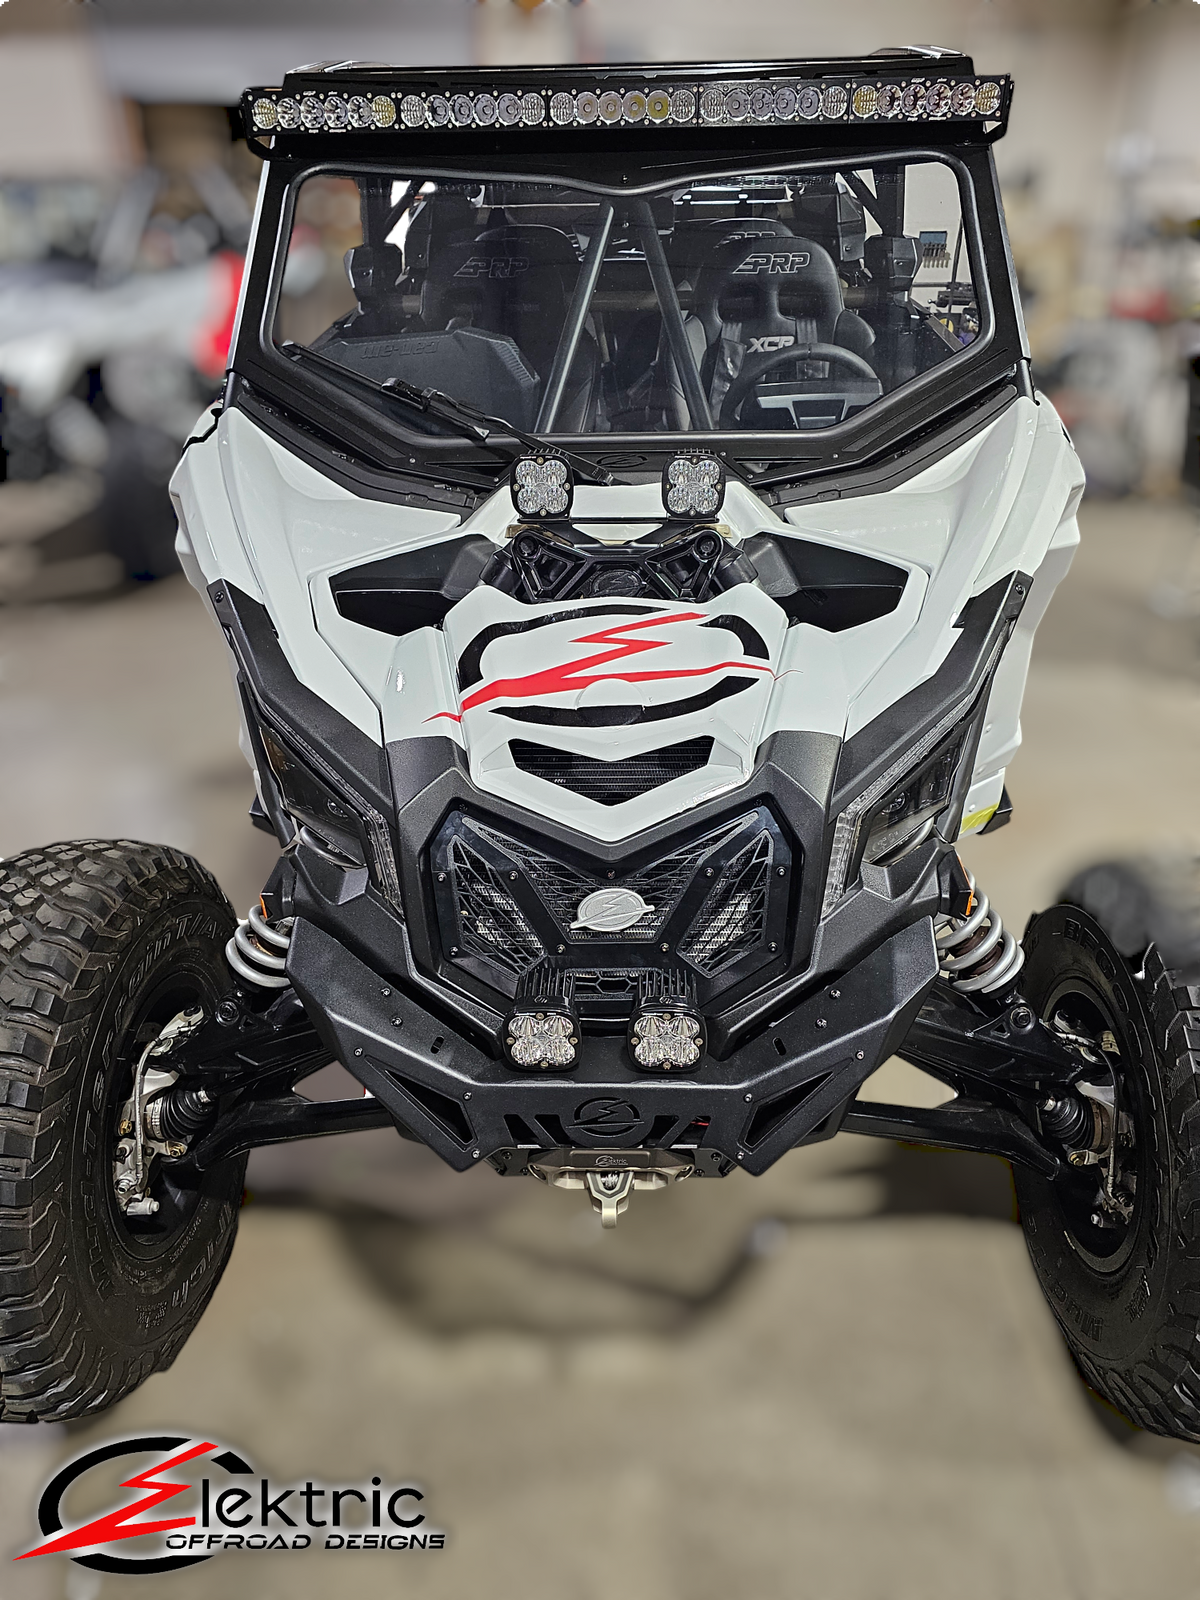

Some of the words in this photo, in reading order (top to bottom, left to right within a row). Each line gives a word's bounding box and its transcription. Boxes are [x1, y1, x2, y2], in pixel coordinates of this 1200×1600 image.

[453, 256, 530, 278] PRP
[732, 252, 811, 275] PRP
[746, 336, 795, 353] XCP
[176, 913, 218, 940] T/A
